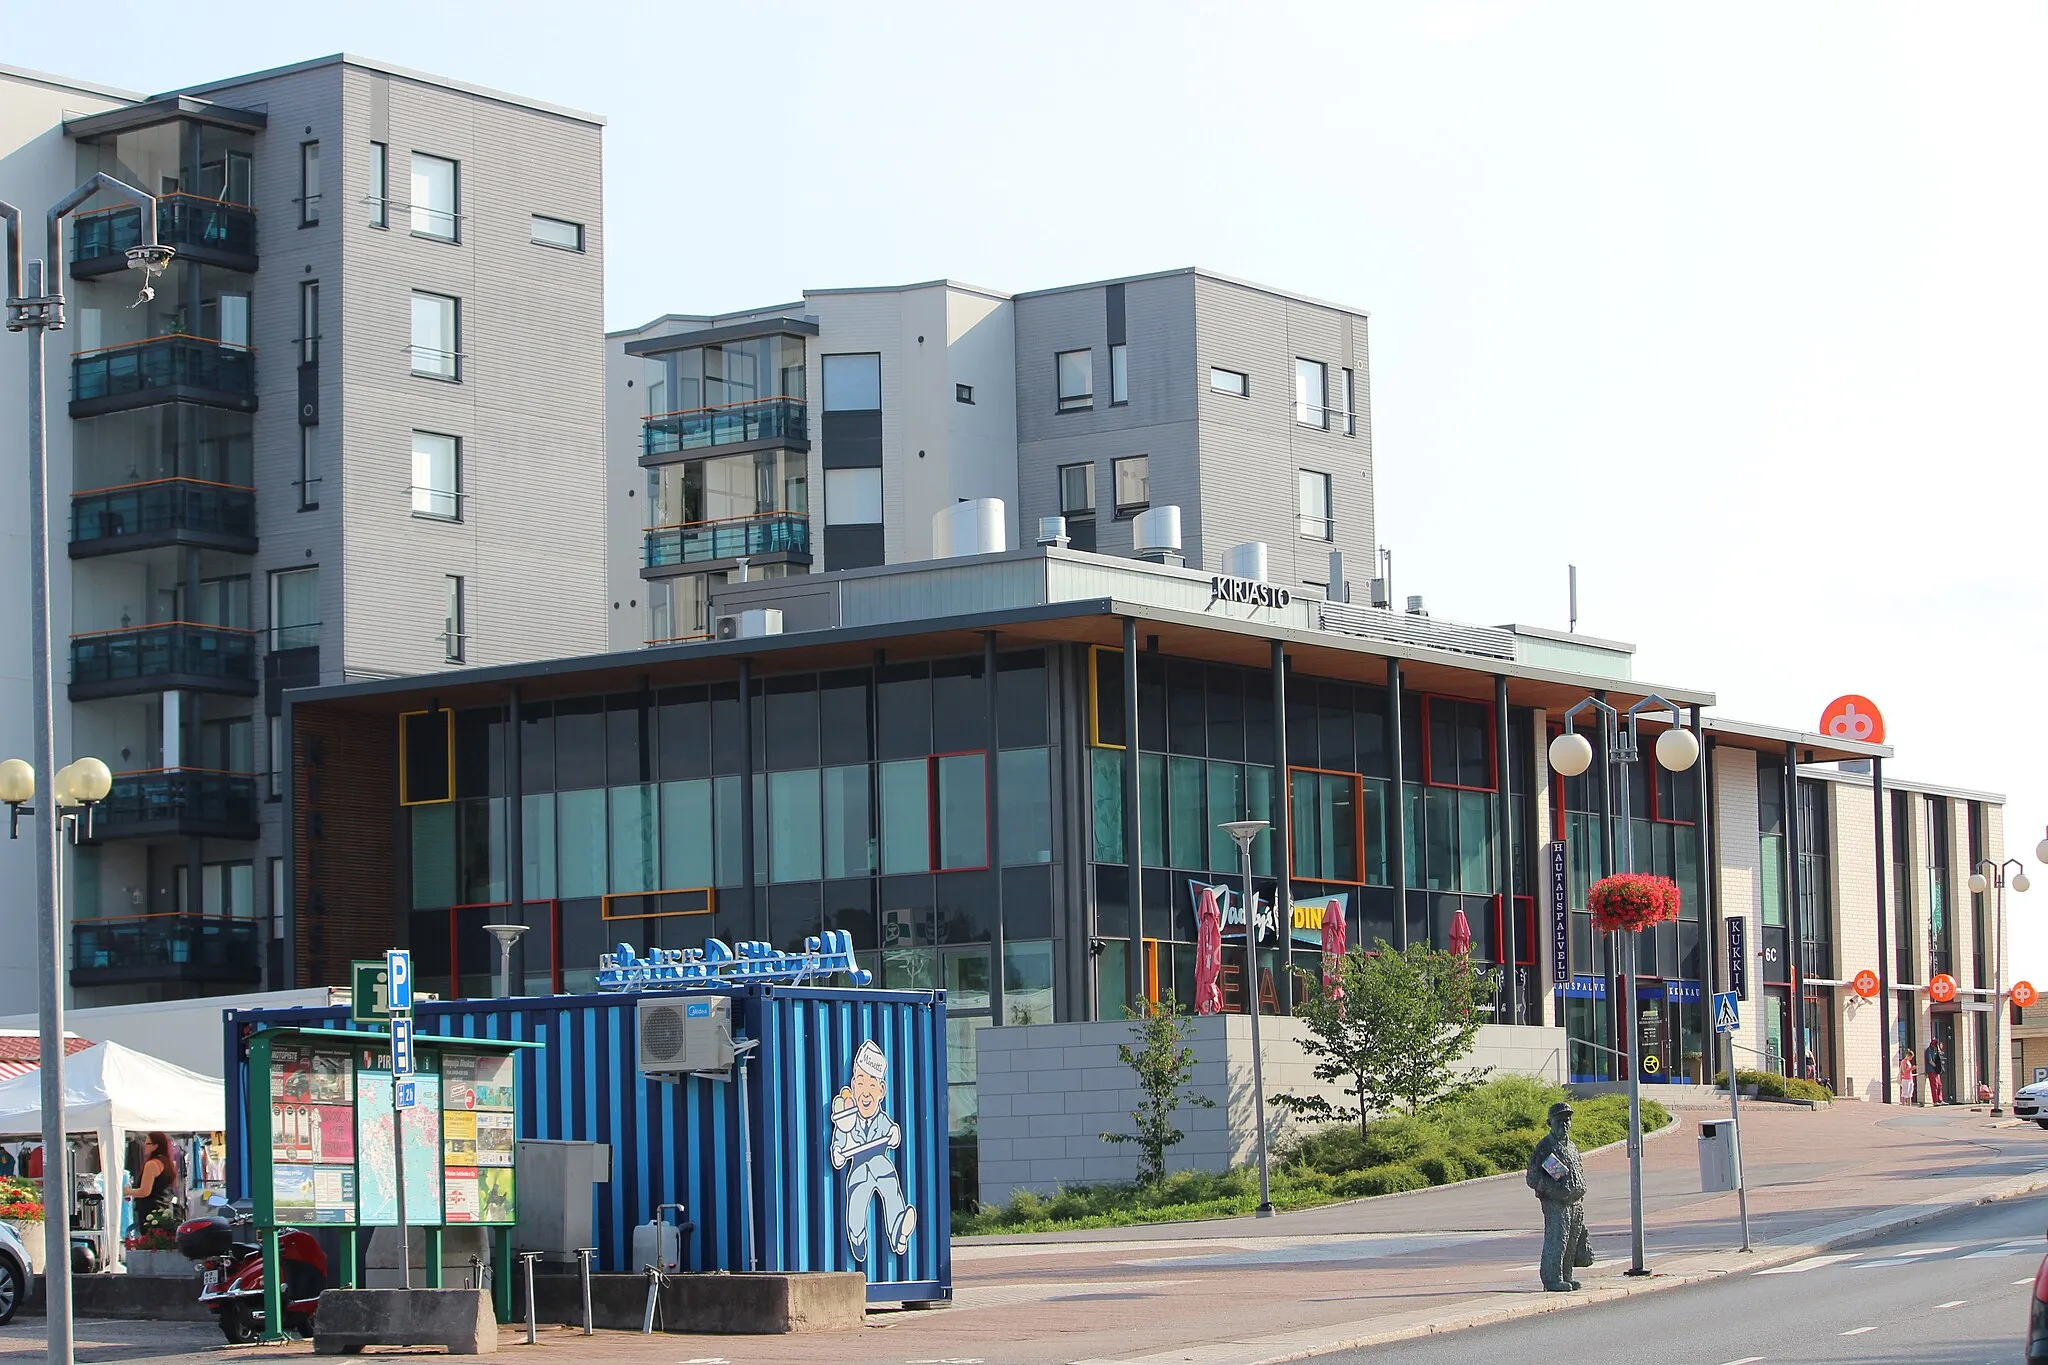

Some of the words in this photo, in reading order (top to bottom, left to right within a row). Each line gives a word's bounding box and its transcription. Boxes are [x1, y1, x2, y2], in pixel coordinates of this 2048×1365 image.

[1212, 576, 1292, 609] KIRJASTO
[1294, 907, 1326, 930] DIN
[1553, 843, 1566, 980] HAUTAUSPALVELU
[1731, 921, 1743, 997] KUKKIA
[1765, 947, 1777, 963] 6C
[392, 955, 407, 1005] P
[1554, 982, 1605, 993] AUSPALVE
[1669, 987, 1700, 997] KKAKAU
[377, 1054, 418, 1071] PIRA
[859, 1052, 883, 1073] Minetti
[405, 1088, 414, 1102] 2h
